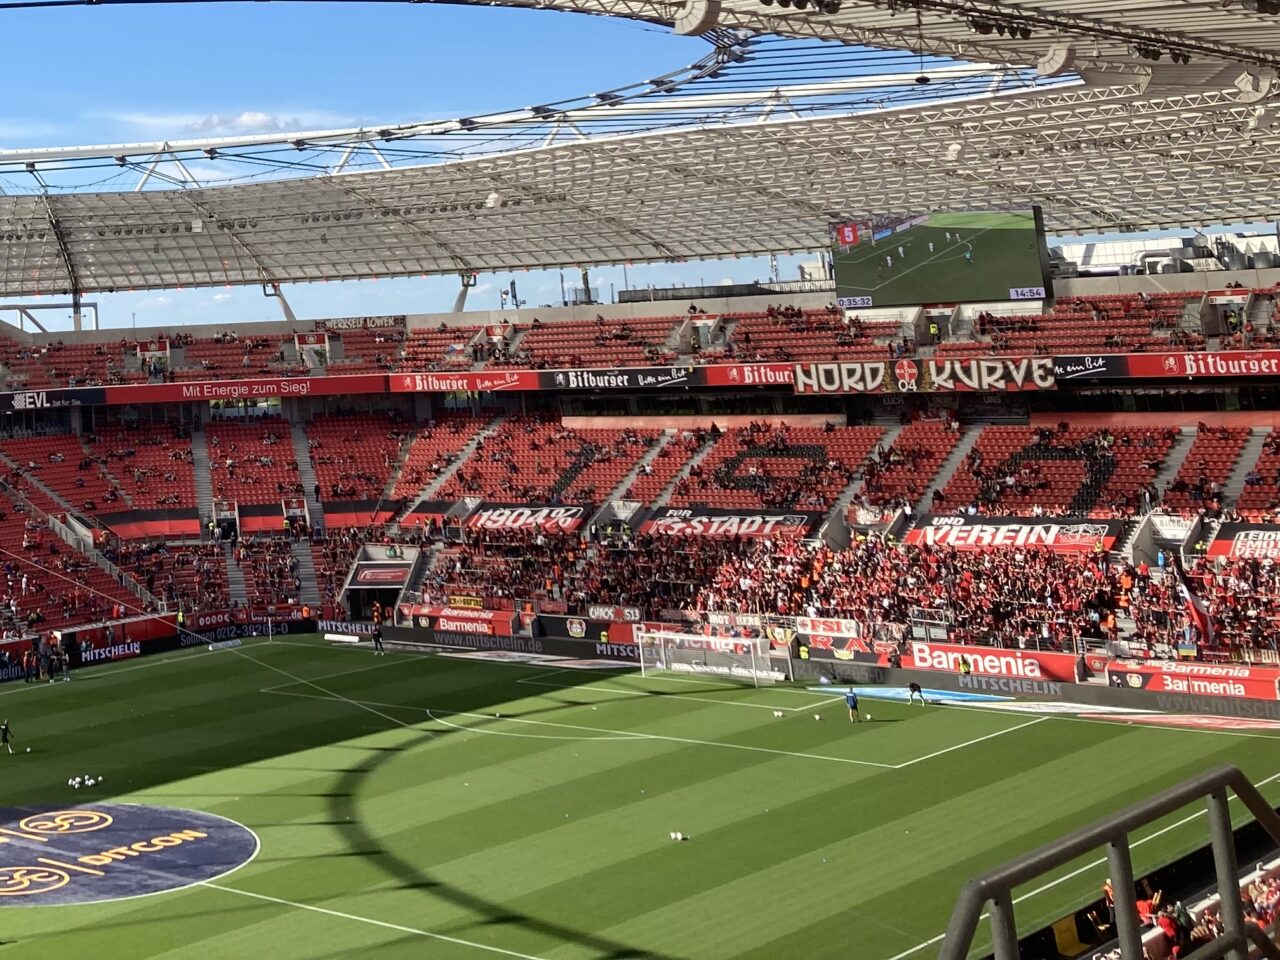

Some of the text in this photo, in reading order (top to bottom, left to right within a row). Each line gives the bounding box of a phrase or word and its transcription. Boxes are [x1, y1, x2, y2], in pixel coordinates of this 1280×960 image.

[1014, 289, 1042, 298] 14:54
[1067, 364, 1084, 372] ein
[1085, 357, 1106, 367] Bit
[1184, 354, 1279, 375] Bitburger
[415, 375, 469, 391] Bitburger
[506, 373, 519, 384] Bit
[569, 370, 629, 388] Bitburger
[638, 369, 687, 386] Bitte ein Bit
[793, 358, 1054, 392] NORD KURVE
[182, 381, 311, 398] Mit Energie zum Sieg!
[898, 380, 918, 392] 04
[25, 392, 50, 408] EVL
[478, 508, 579, 528] 1904%
[931, 516, 965, 526] UND
[919, 524, 1058, 546] VEREIN
[588, 605, 614, 619] CHAOS
[440, 618, 488, 632] Barmenia
[433, 632, 543, 653] www.mitschelin.de
[81, 641, 141, 663] MITSCHELIN
[913, 643, 1041, 677] Barmenia
[1161, 661, 1250, 678] Barmenia
[958, 675, 1063, 696] MITSCHELIN
[77, 828, 208, 866] DITCON
